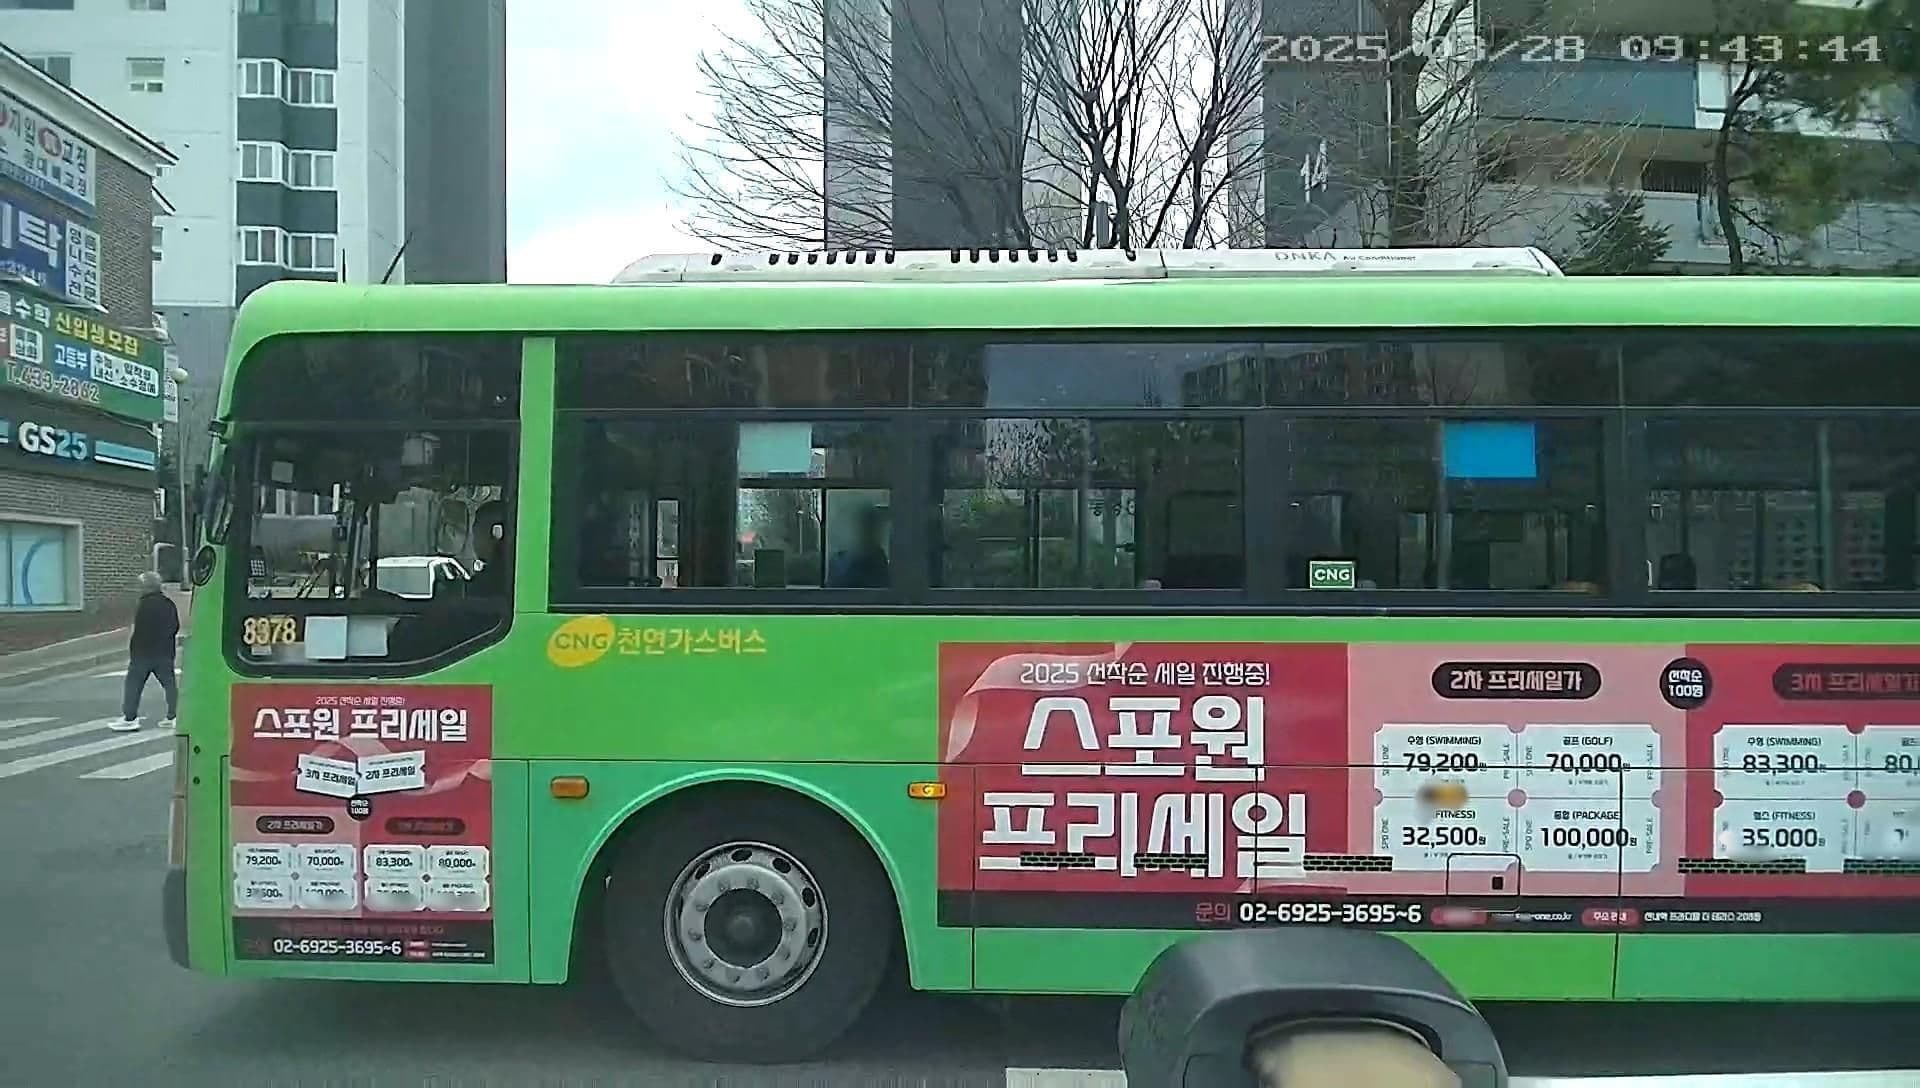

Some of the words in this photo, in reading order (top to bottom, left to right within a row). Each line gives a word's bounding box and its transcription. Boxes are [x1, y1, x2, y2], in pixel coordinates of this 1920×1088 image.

[0, 201, 61, 268] 탁
[55, 312, 105, 345] 신입생
[108, 329, 138, 356] 모집
[54, 343, 88, 371] 고등부
[18, 421, 88, 460] GS25
[1314, 568, 1351, 581] CNG
[555, 629, 609, 651] CNG
[617, 625, 766, 656] 천연가스버스
[1021, 662, 1079, 684] 2025
[1086, 662, 1148, 685] 선착순
[1154, 662, 1195, 686] 세일
[1202, 662, 1270, 686] 진행중!
[1450, 670, 1483, 690] 2차
[1487, 670, 1582, 691] 프리세일가
[1668, 684, 1704, 697] 100명
[254, 708, 340, 741] 스포원
[350, 708, 468, 742] 프리세일
[1021, 695, 1265, 782] 스포원
[1426, 736, 1482, 746] (SWIMMING)
[1582, 736, 1613, 746] (GOLF)
[1766, 737, 1822, 747] (SWIMMING)
[322, 771, 356, 786] 프리세일
[382, 766, 416, 779] 프리세일
[1572, 811, 1621, 820] (PACKAGE
[1772, 811, 1816, 821] (FITNESS)
[979, 792, 1306, 878] 프리세일
[1195, 903, 1231, 922] 문의
[1240, 903, 1422, 922] 02-6925-3695~6
[273, 938, 401, 955] 02-6925-3695~6
